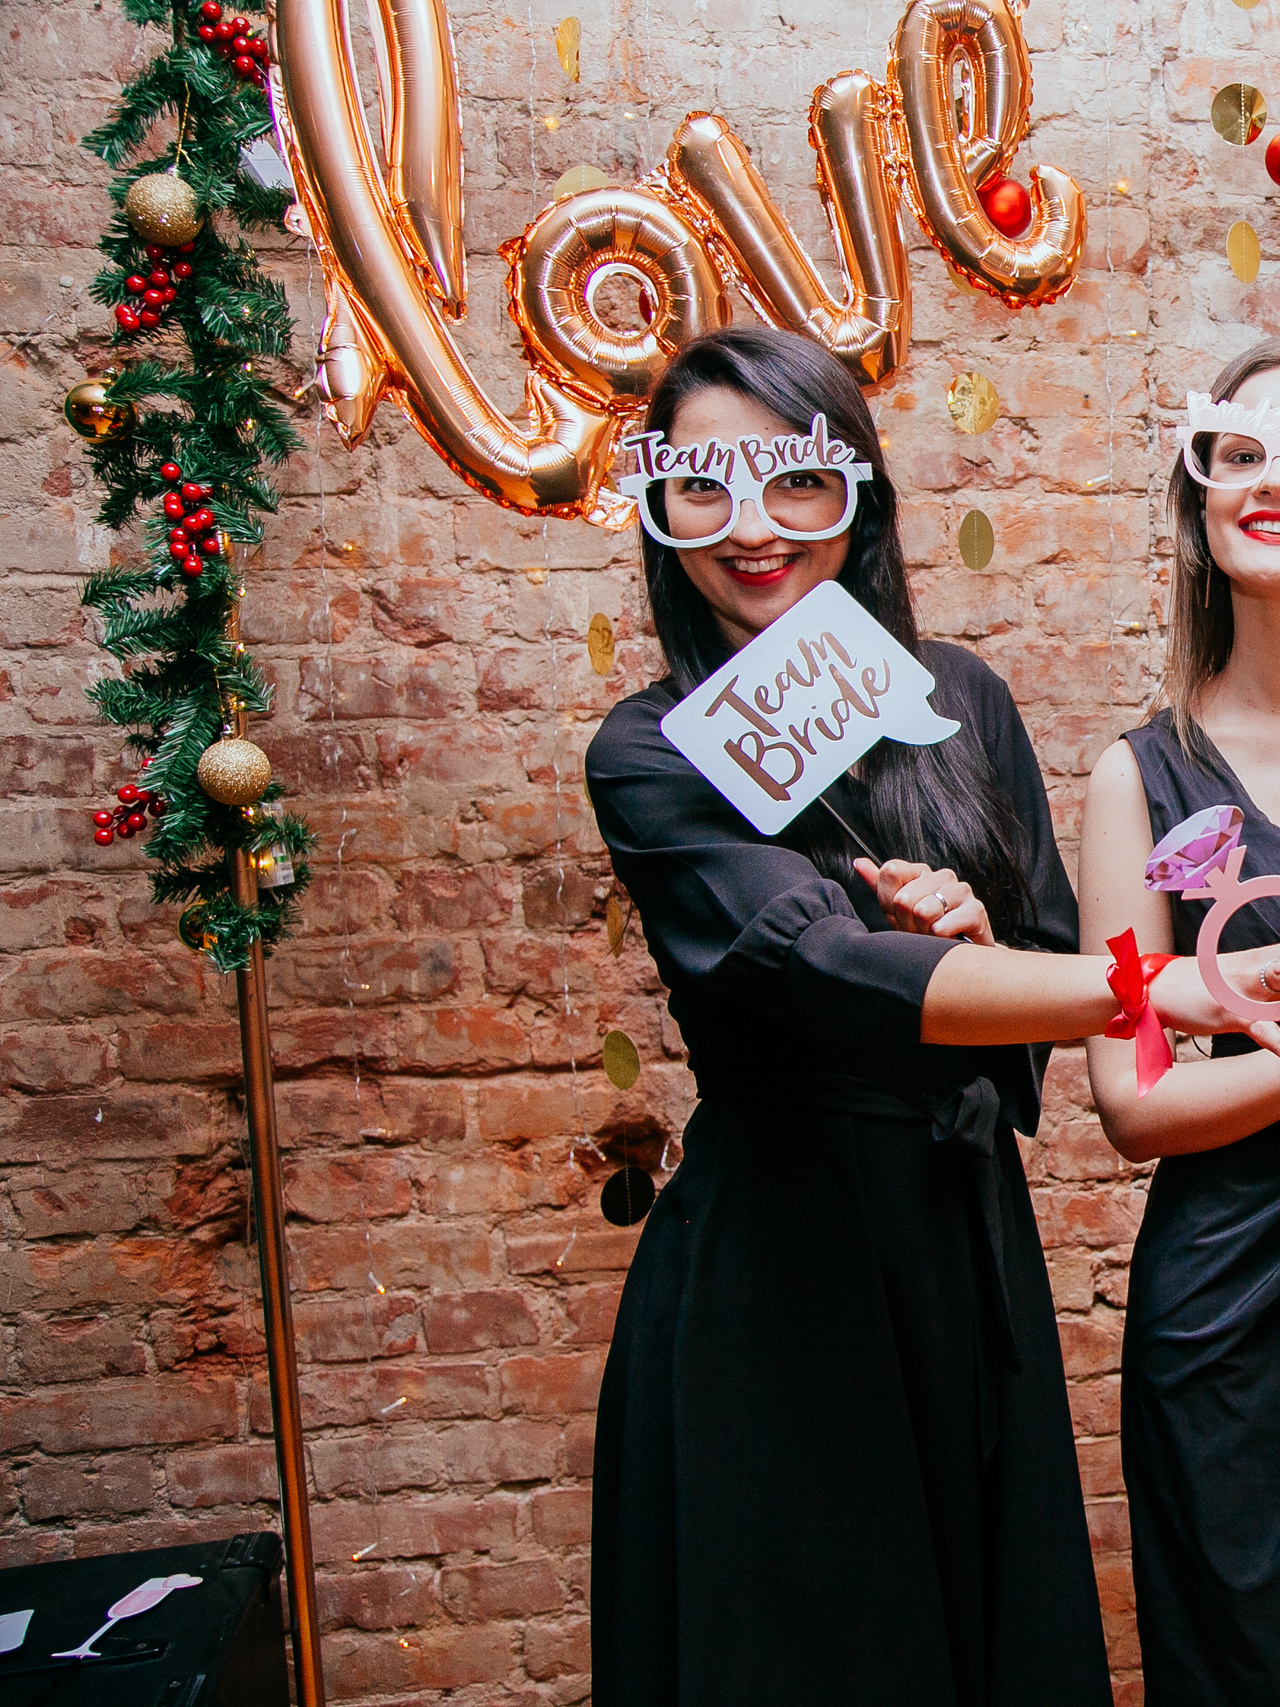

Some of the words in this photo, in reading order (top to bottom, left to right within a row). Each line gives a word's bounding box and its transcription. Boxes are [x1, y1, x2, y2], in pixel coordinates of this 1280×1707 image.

[624, 434, 735, 484] Team
[739, 417, 851, 482] Bride
[1189, 394, 1280, 438] Bride
[704, 631, 857, 737] Team
[723, 658, 891, 802] Bride
